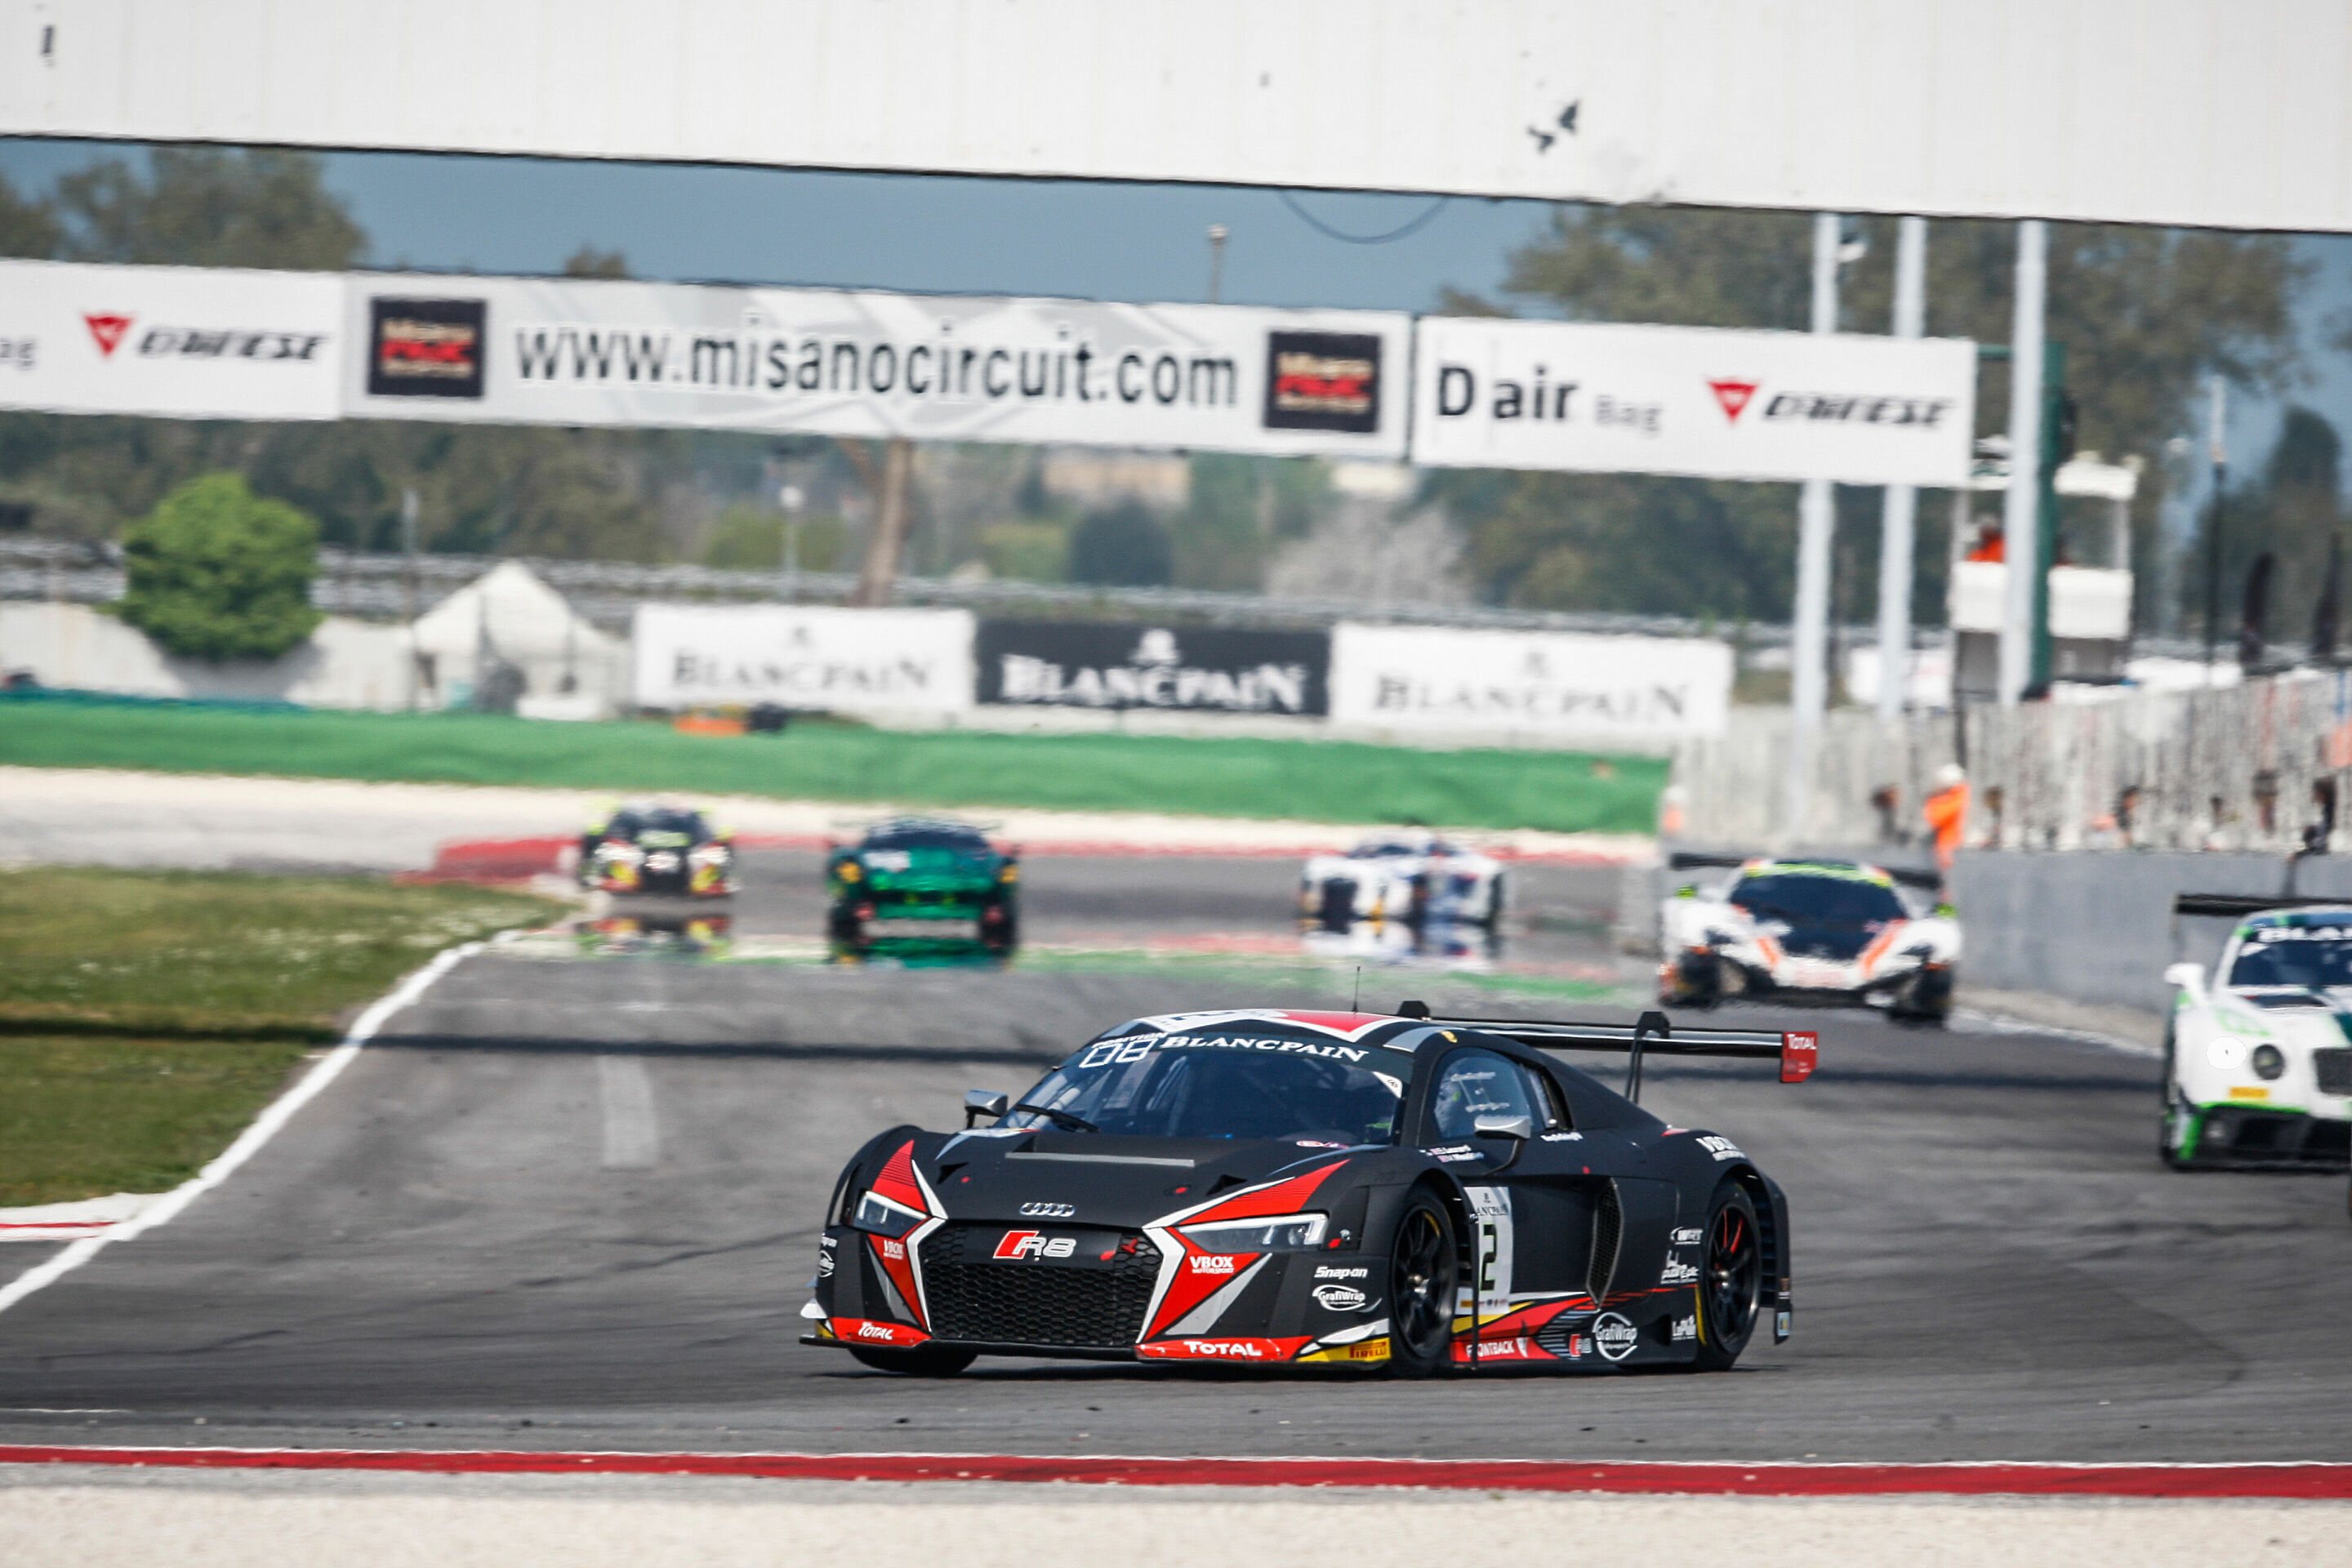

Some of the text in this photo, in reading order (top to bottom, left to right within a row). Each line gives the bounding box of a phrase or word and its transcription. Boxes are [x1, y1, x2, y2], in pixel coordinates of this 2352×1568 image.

[514, 314, 1238, 406] www.misanocircuit.com
[1439, 365, 1661, 434] D air Bag
[674, 653, 933, 693] BLANCPAIN
[1001, 653, 1305, 713] BLANCPAIN
[1160, 1036, 1369, 1062] BLANCPAIN
[1787, 1033, 1817, 1050] TOTAL
[1009, 1234, 1076, 1258] R8
[1480, 1223, 1497, 1291] 2
[1189, 1255, 1234, 1268] VBOX
[1313, 1266, 1368, 1280] Snap-on
[858, 1321, 893, 1341] TOTAL
[1183, 1340, 1263, 1356] TOTAL
[1466, 1340, 1516, 1358] FONTBACK
